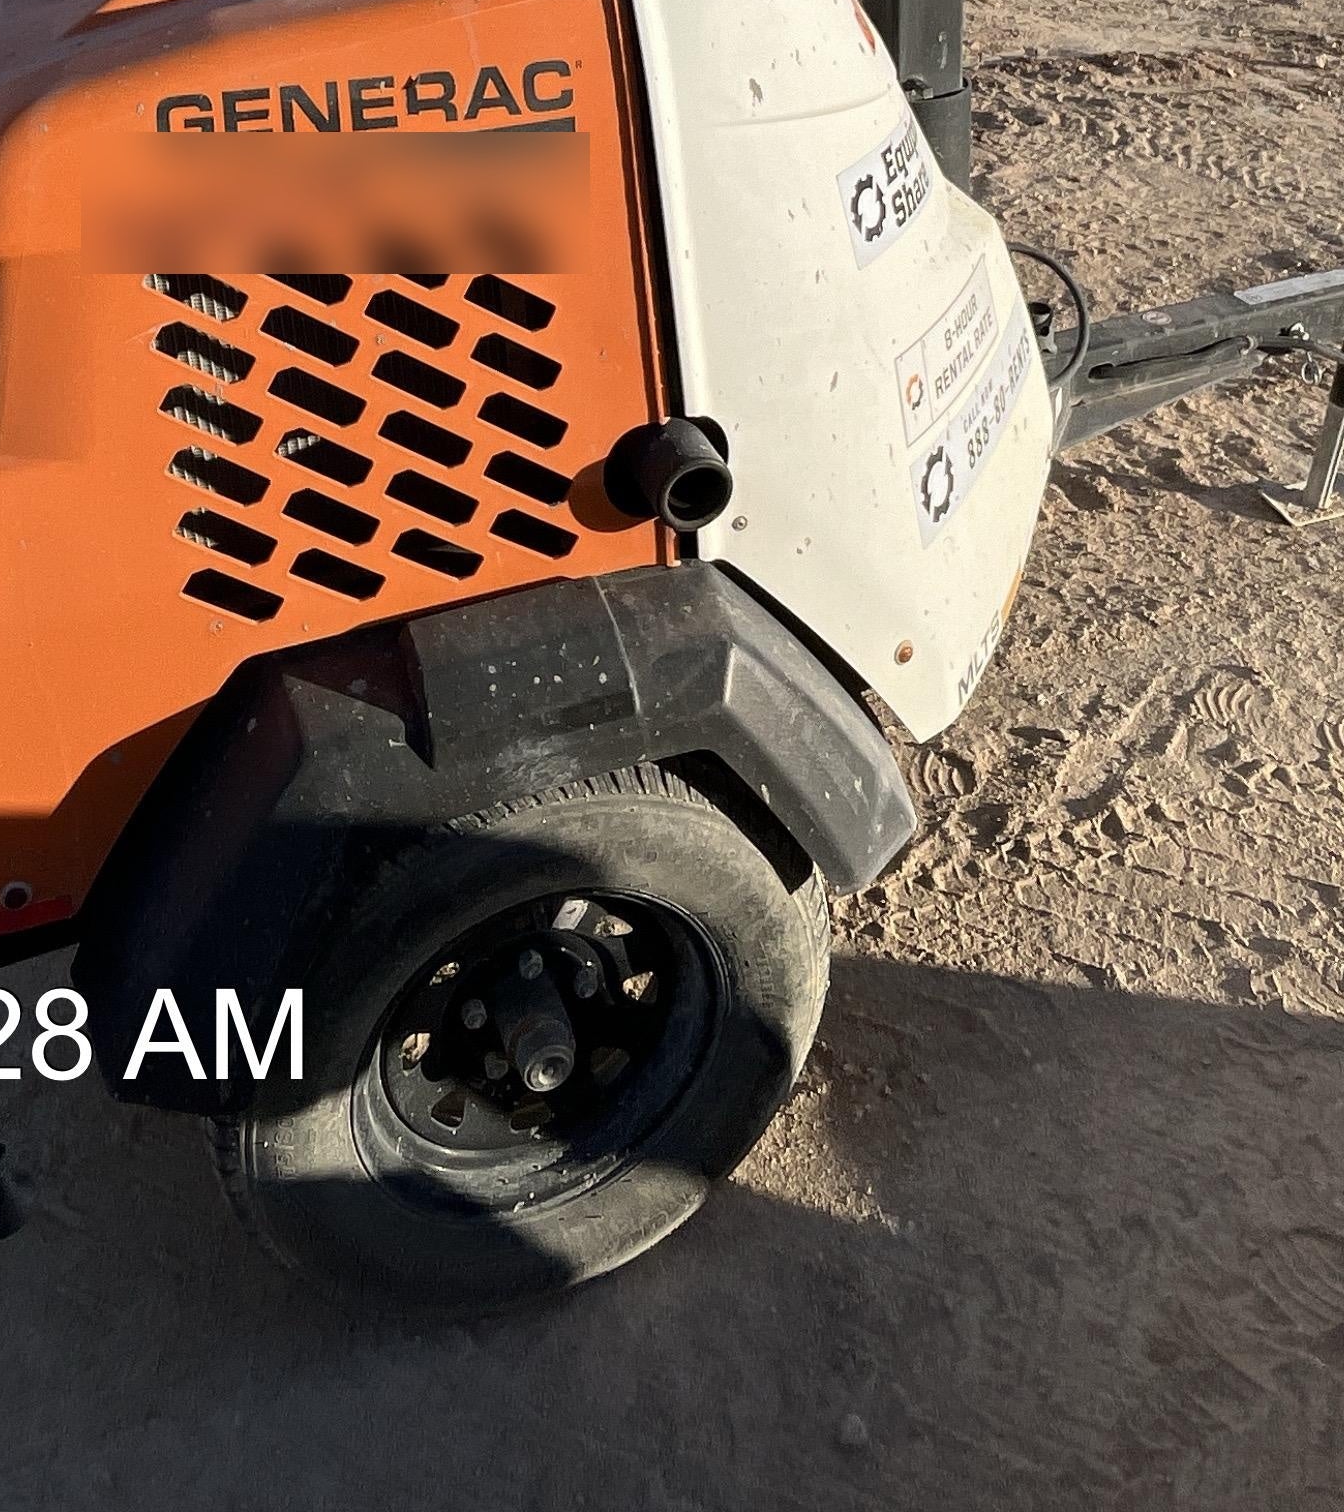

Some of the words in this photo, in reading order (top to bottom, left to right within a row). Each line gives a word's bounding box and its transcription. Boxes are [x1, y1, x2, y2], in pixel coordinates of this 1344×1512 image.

[156, 59, 575, 133] GENERAC
[934, 344, 974, 400] RENTAL
[972, 306, 993, 350] RATE
[944, 293, 978, 351] 8-HOUR
[967, 327, 1030, 470] 888-80-RENTS
